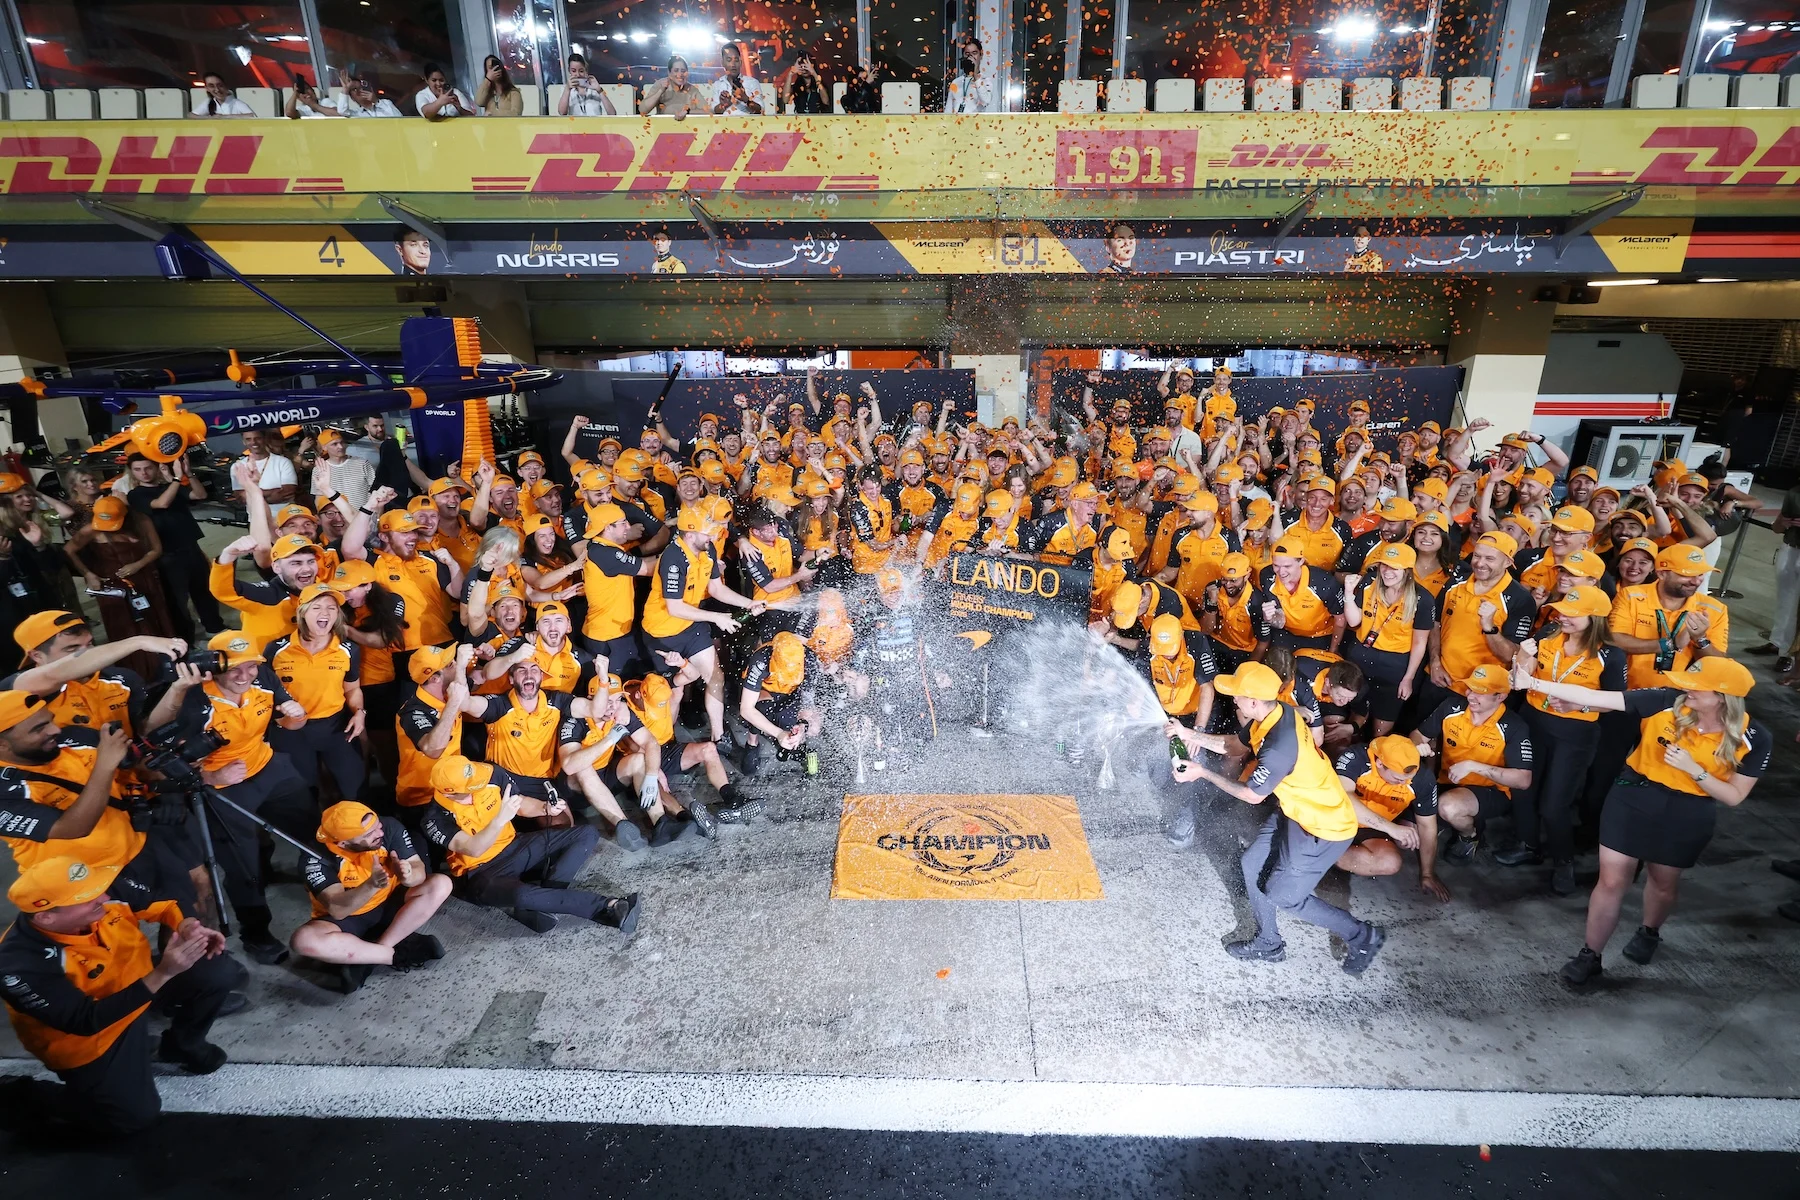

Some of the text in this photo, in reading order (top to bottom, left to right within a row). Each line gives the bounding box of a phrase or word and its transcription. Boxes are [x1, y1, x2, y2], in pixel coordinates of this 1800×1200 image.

[527, 132, 824, 199] DHL
[1228, 144, 1335, 168] DHL
[0, 136, 290, 200] DHL
[1205, 179, 1310, 198] FASTEST
[1430, 178, 1490, 198] 2025
[318, 236, 345, 268] 4
[529, 228, 563, 258] Lando
[1001, 233, 1047, 266] 81
[1210, 229, 1254, 255] Oscar
[497, 253, 619, 268] NORRIS
[1174, 251, 1305, 267] PIASTRI
[237, 407, 320, 429] DP WORLD
[582, 422, 619, 432] cLaren
[1366, 420, 1401, 430] cLaren
[952, 557, 1060, 598] LANDO
[950, 600, 1034, 620] WORLD CHAMPION
[877, 833, 1052, 850] CHAMPION
